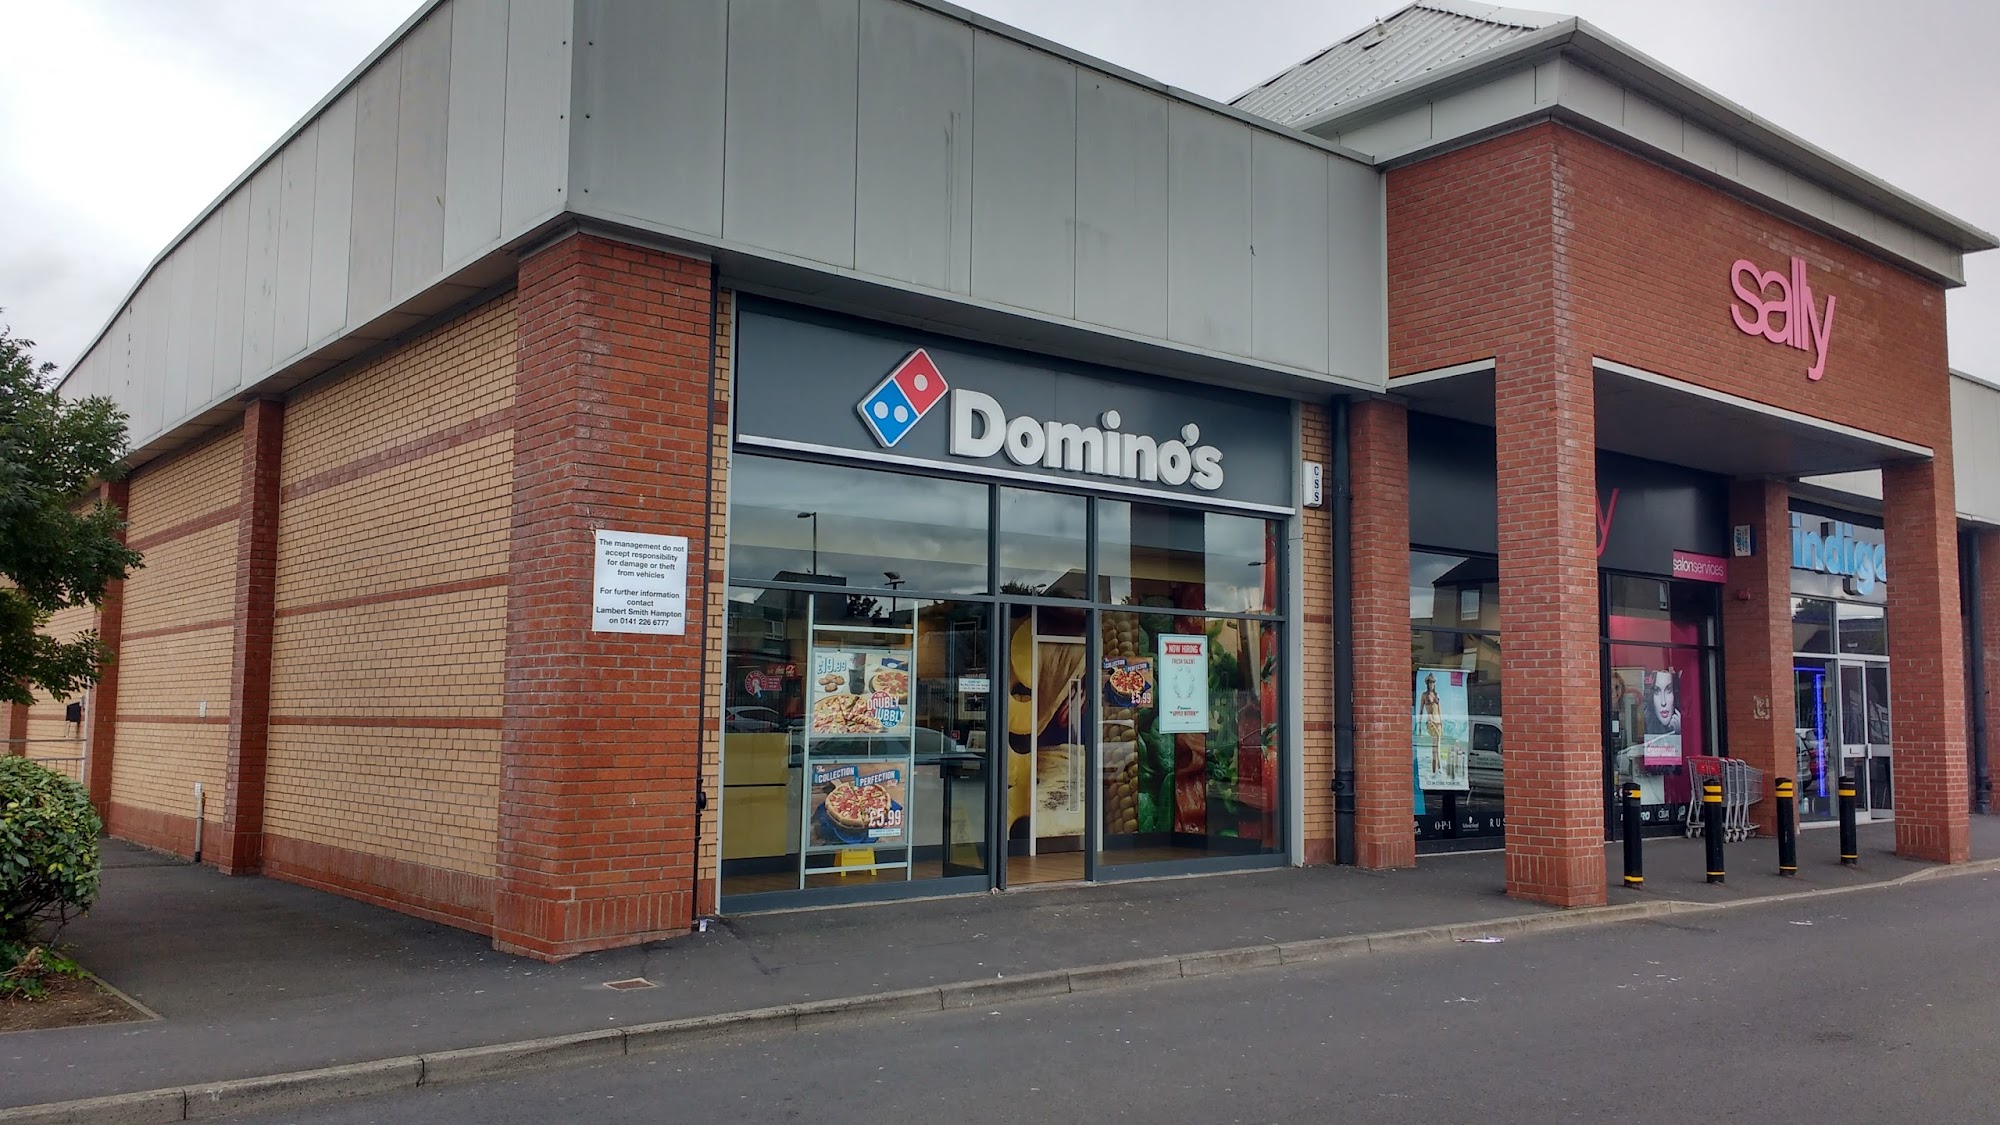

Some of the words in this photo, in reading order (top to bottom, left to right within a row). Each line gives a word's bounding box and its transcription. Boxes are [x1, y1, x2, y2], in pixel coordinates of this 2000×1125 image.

[1730, 256, 1836, 381] sally
[949, 388, 1224, 491] Domino's
[599, 538, 613, 547] The
[614, 540, 661, 551] management
[662, 544, 672, 552] do
[673, 545, 685, 553] not
[605, 549, 630, 558] accept
[631, 551, 678, 562] responsibility
[619, 559, 648, 569] damage
[659, 562, 676, 570] theft
[1672, 556, 1724, 577] salonservices
[617, 569, 635, 577] from
[636, 570, 665, 579] vehicles
[614, 587, 639, 596] further
[640, 589, 680, 599] information
[626, 599, 654, 607] contact
[596, 606, 627, 615] Lambert
[628, 608, 649, 616] Smith
[650, 609, 682, 618] Hampton
[619, 617, 637, 625] 0141
[1168, 644, 1181, 653] NOW
[1181, 644, 1199, 654] HIRING
[867, 695, 901, 711] DOUBLY
[1131, 690, 1151, 704] £5.99
[874, 707, 906, 723] JUBBLY
[818, 766, 855, 783] COLLECTION
[859, 770, 896, 787] PERFECTION
[868, 807, 901, 827] £5.99
